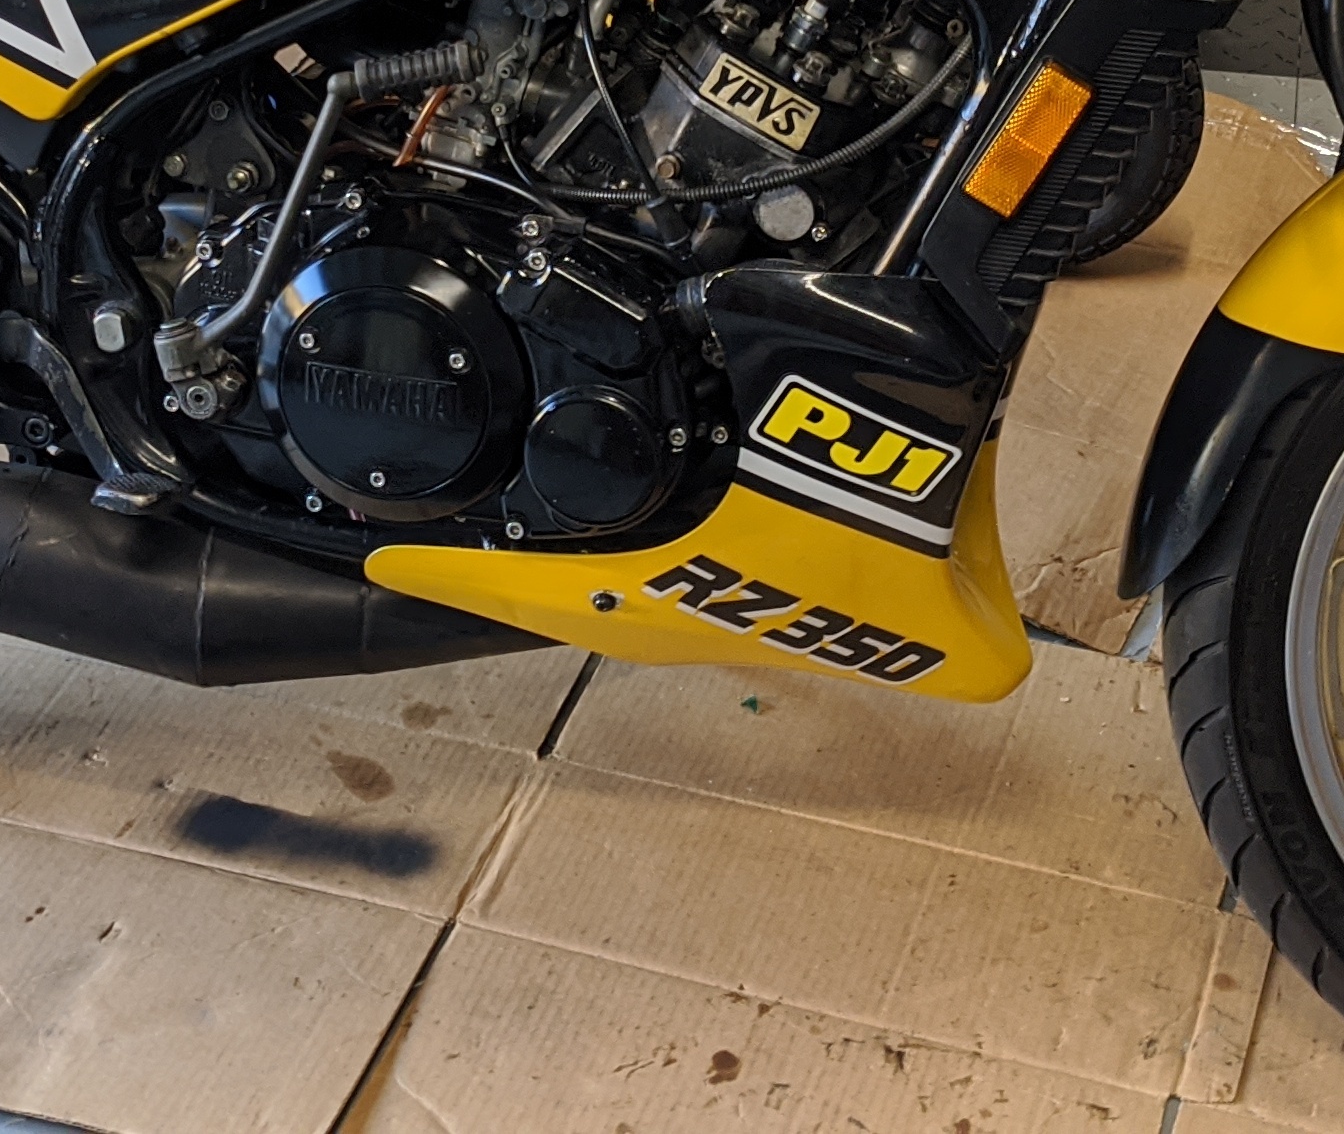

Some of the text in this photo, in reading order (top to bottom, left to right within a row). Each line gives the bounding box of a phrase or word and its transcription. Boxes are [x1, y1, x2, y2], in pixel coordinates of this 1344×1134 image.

[709, 59, 814, 136] YPVS
[309, 363, 453, 424] YAMAHA
[762, 387, 948, 492] PJ1
[642, 554, 947, 685] RZ 350
